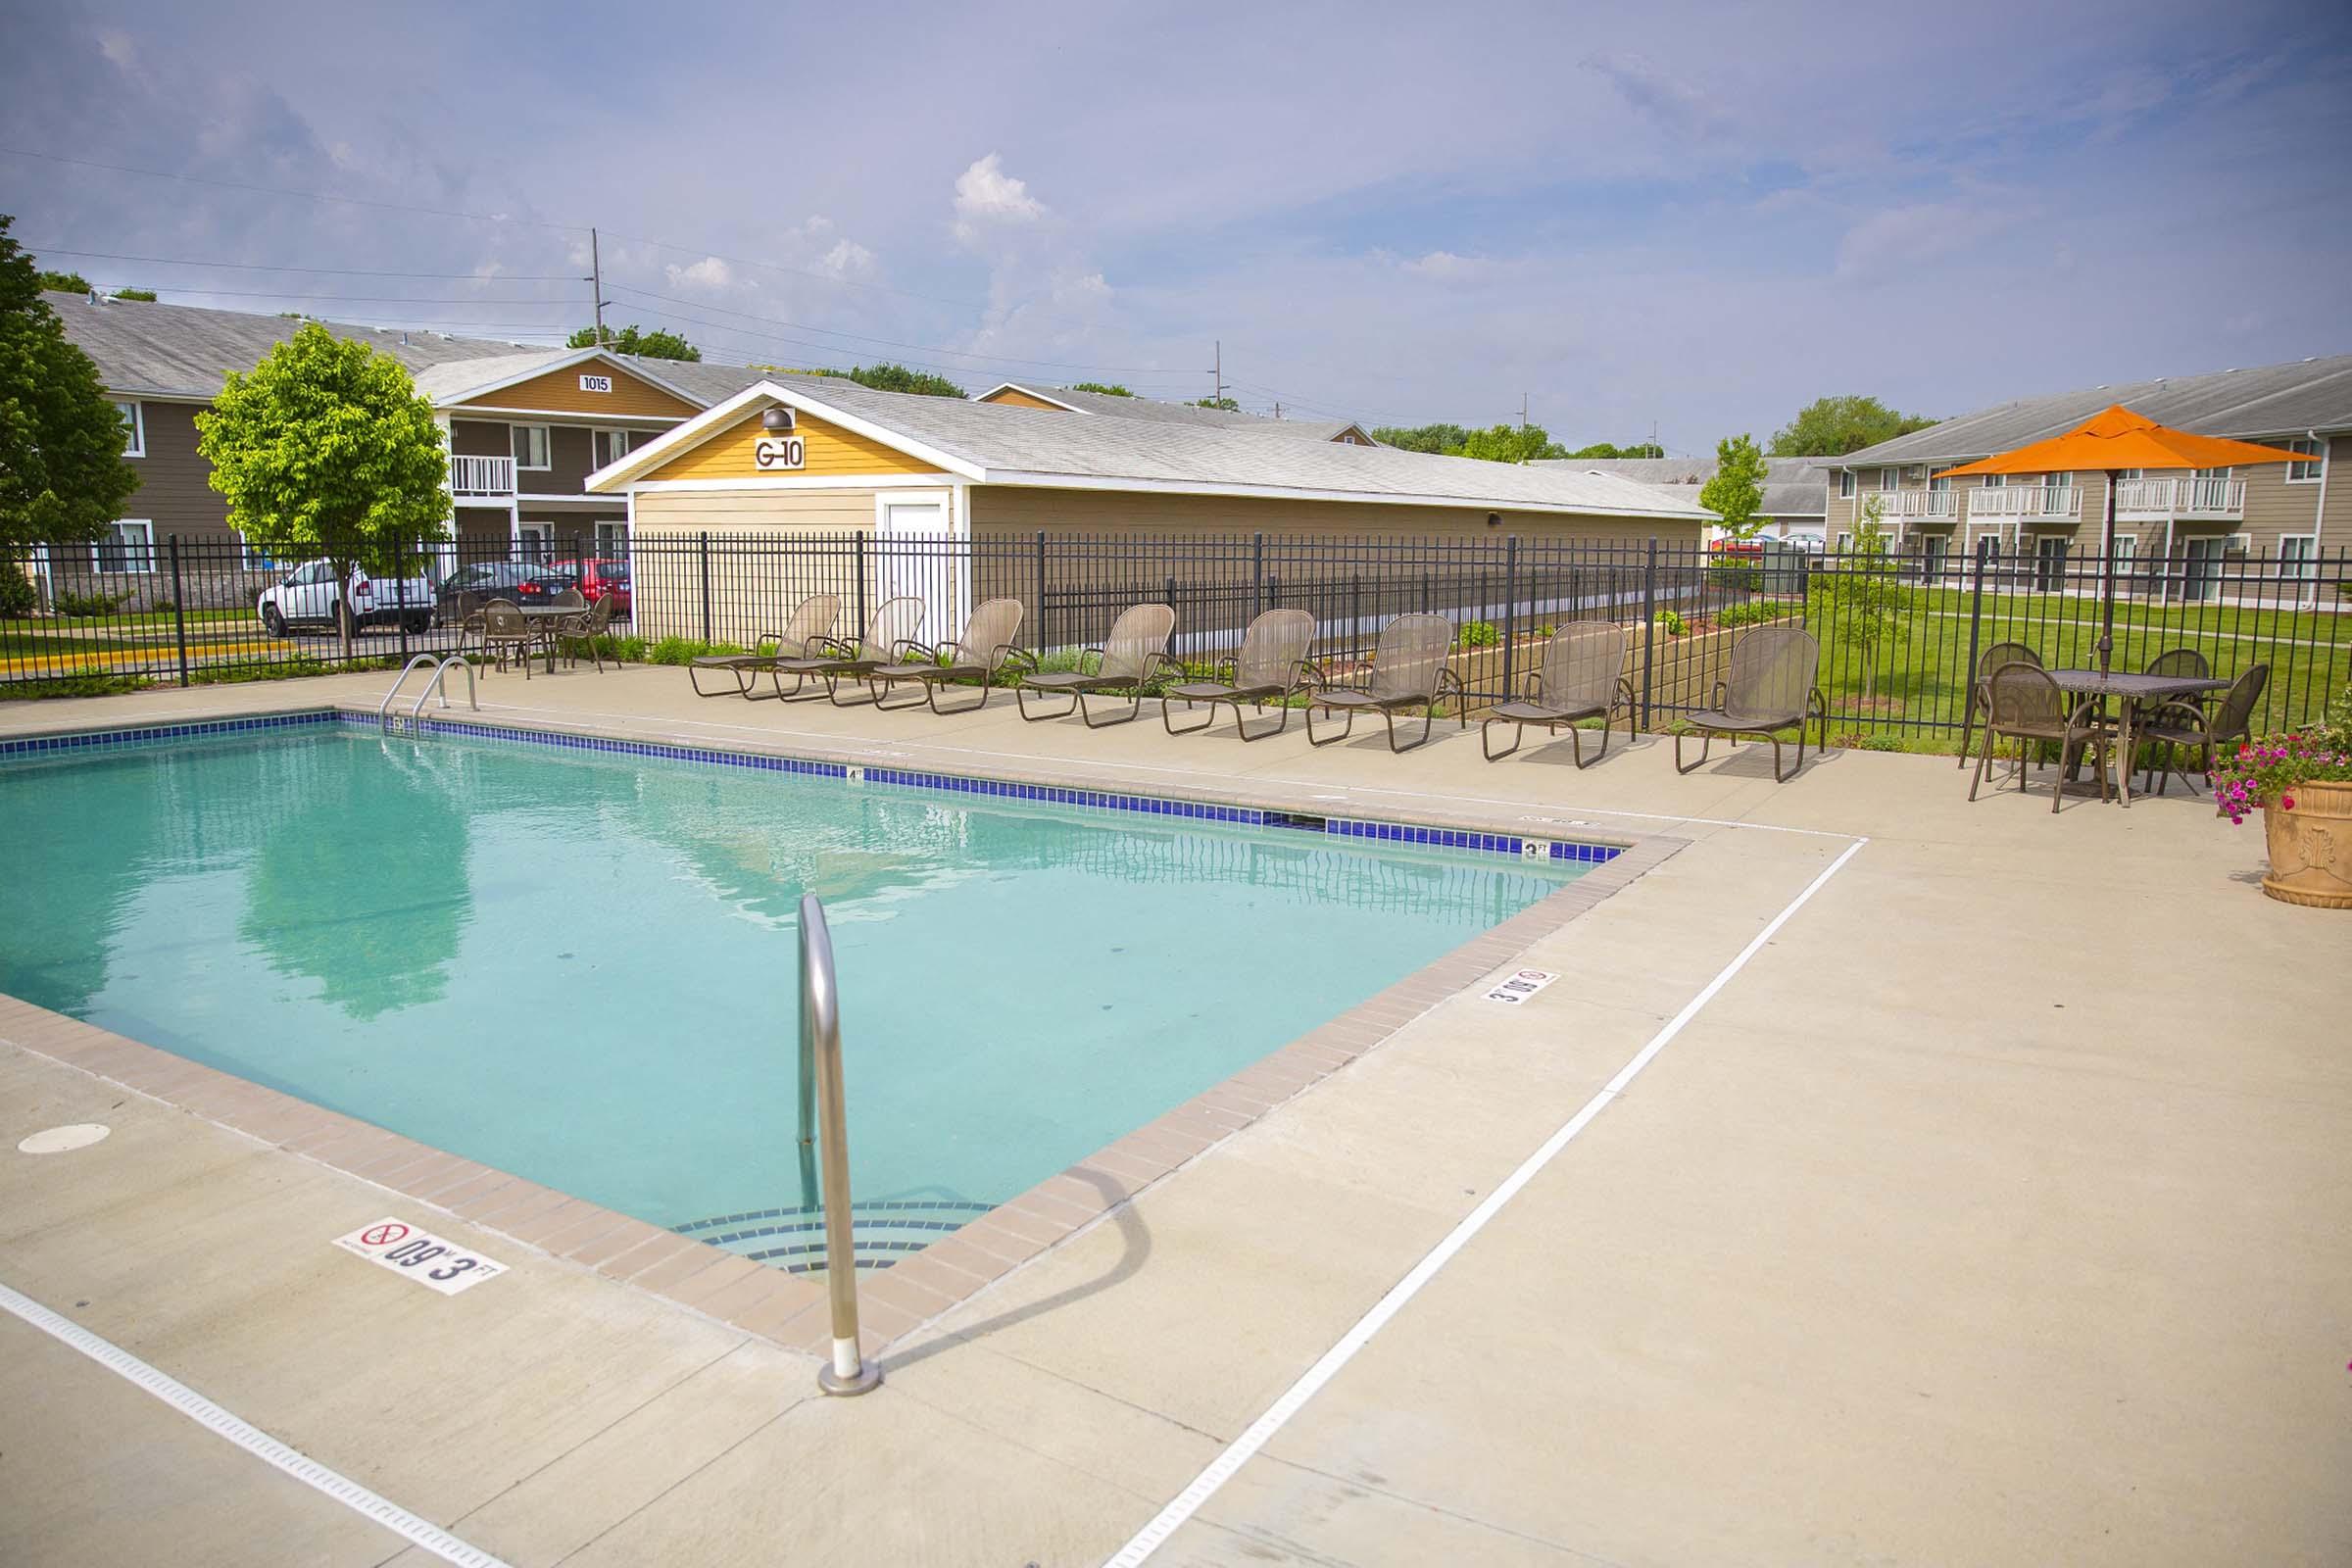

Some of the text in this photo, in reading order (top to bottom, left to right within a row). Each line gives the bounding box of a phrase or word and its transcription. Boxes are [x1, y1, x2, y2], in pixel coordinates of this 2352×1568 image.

[584, 376, 609, 391] 1015
[756, 440, 803, 467] G-10
[428, 1257, 477, 1281] 3
